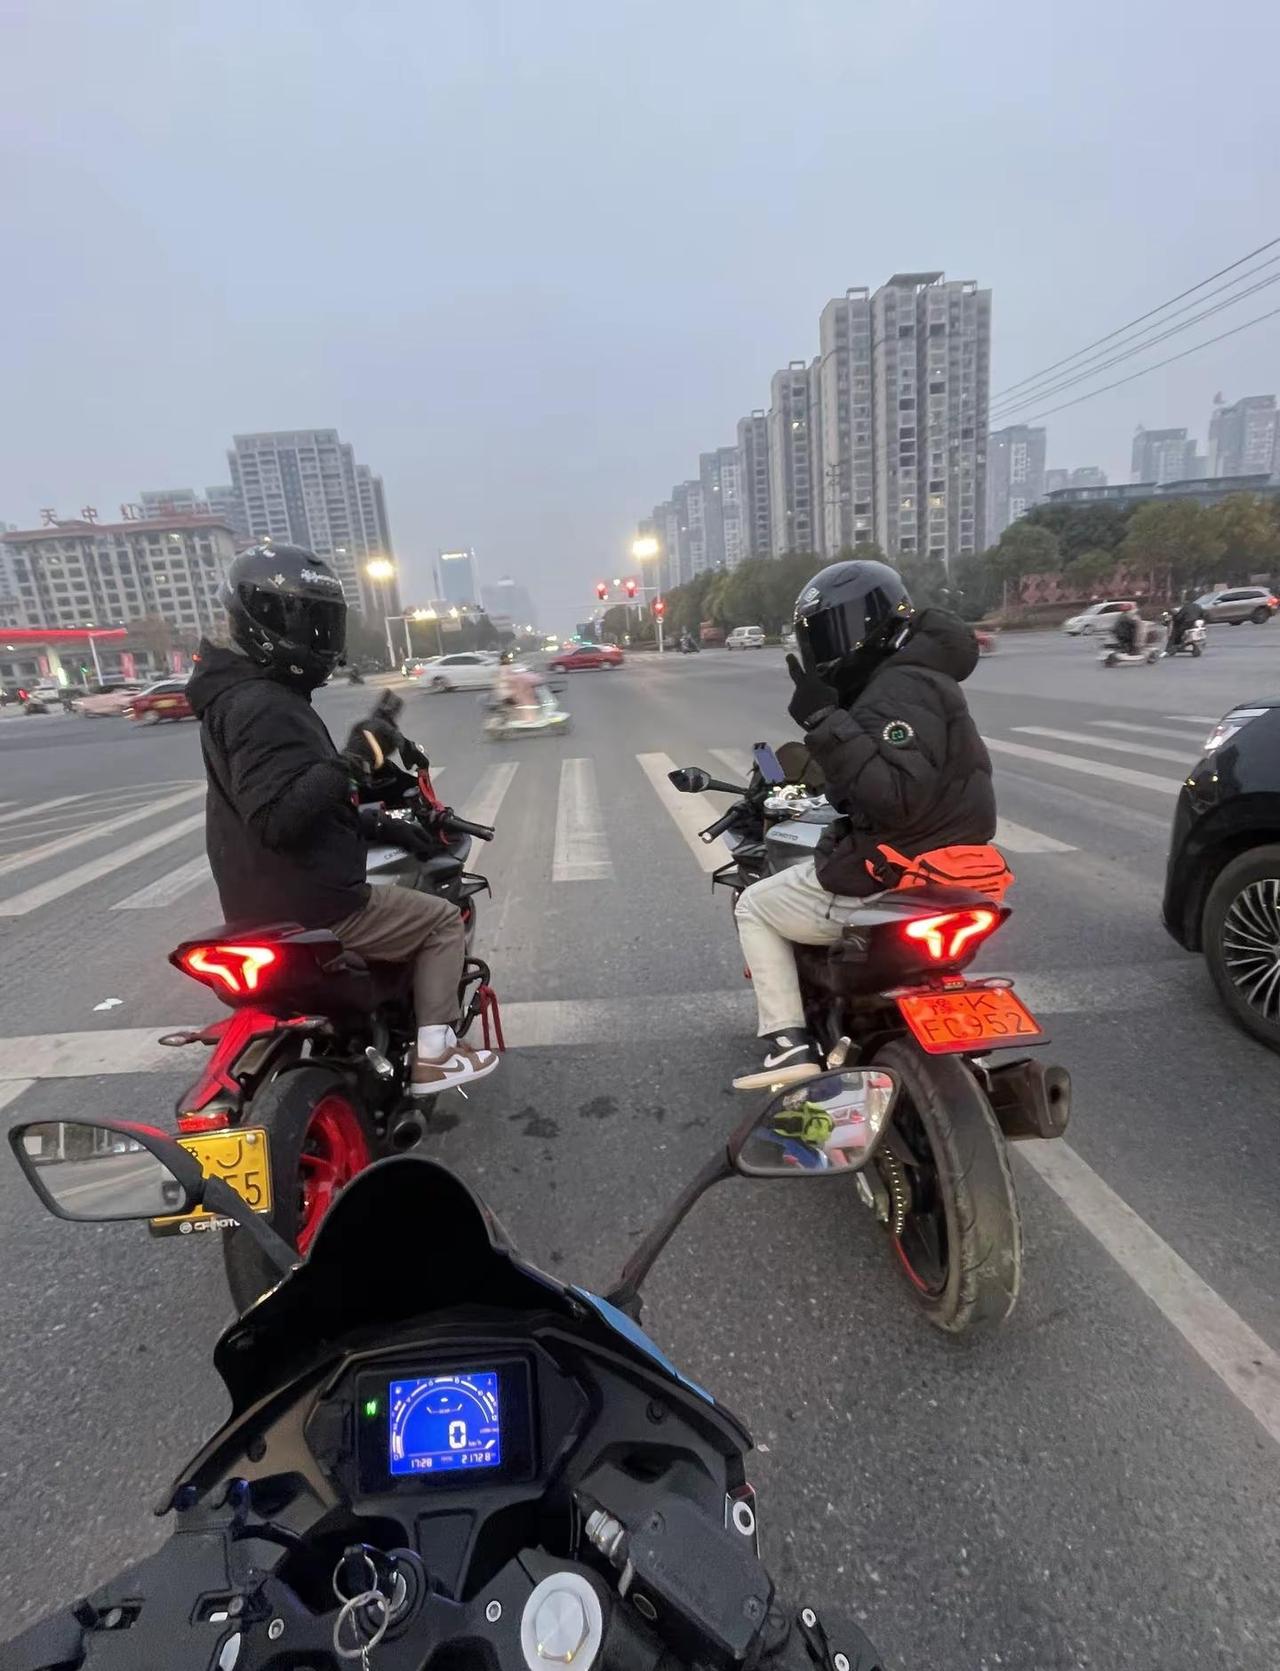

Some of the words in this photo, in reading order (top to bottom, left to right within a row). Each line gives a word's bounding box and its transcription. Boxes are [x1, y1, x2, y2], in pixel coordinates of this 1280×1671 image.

[922, 1013, 1032, 1041] FC952
[448, 1420, 467, 1449] 0
[410, 1458, 433, 1469] 17:28
